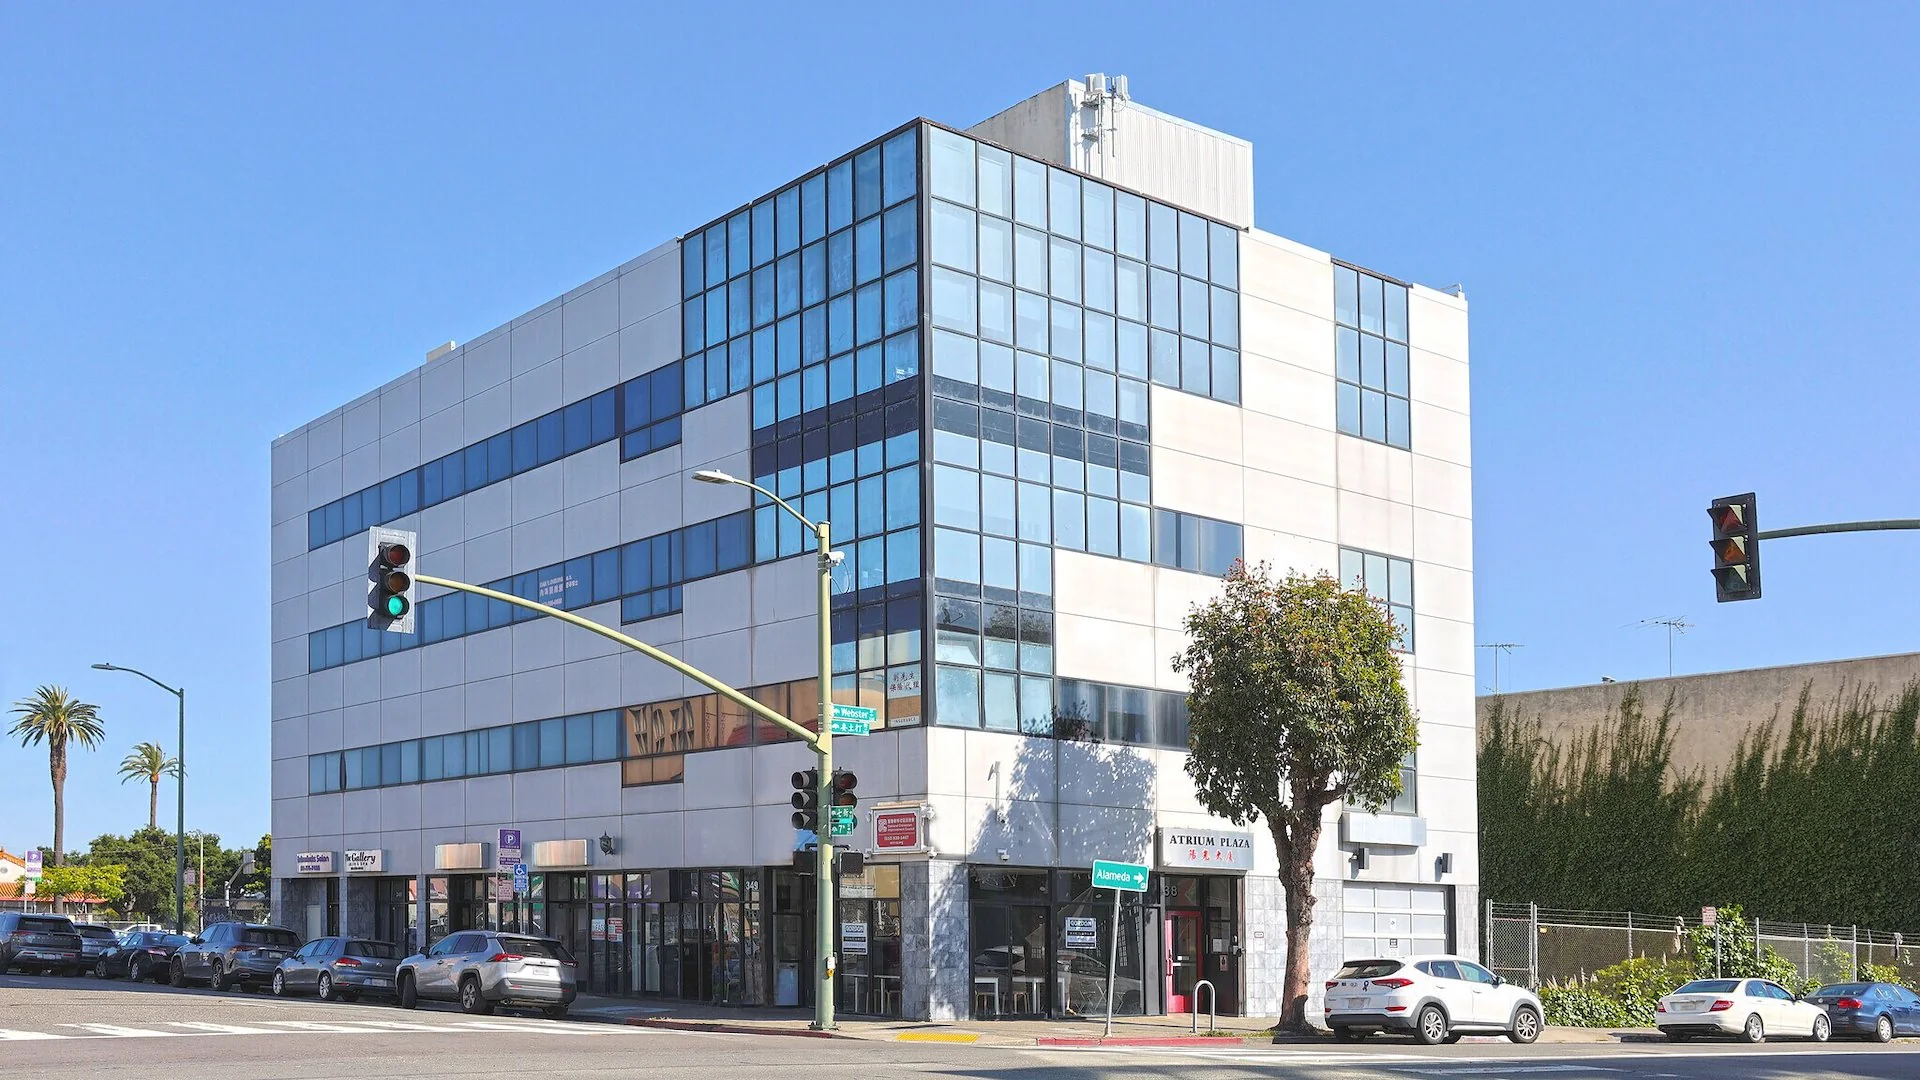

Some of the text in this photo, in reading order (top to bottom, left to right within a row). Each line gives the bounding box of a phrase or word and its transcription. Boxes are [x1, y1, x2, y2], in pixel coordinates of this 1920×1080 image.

[841, 707, 869, 719] Webster
[1170, 835, 1250, 848] ATRIUM PLAZA
[352, 852, 376, 864] Gallery
[1096, 869, 1131, 882] Alameda
[745, 881, 758, 890] 349
